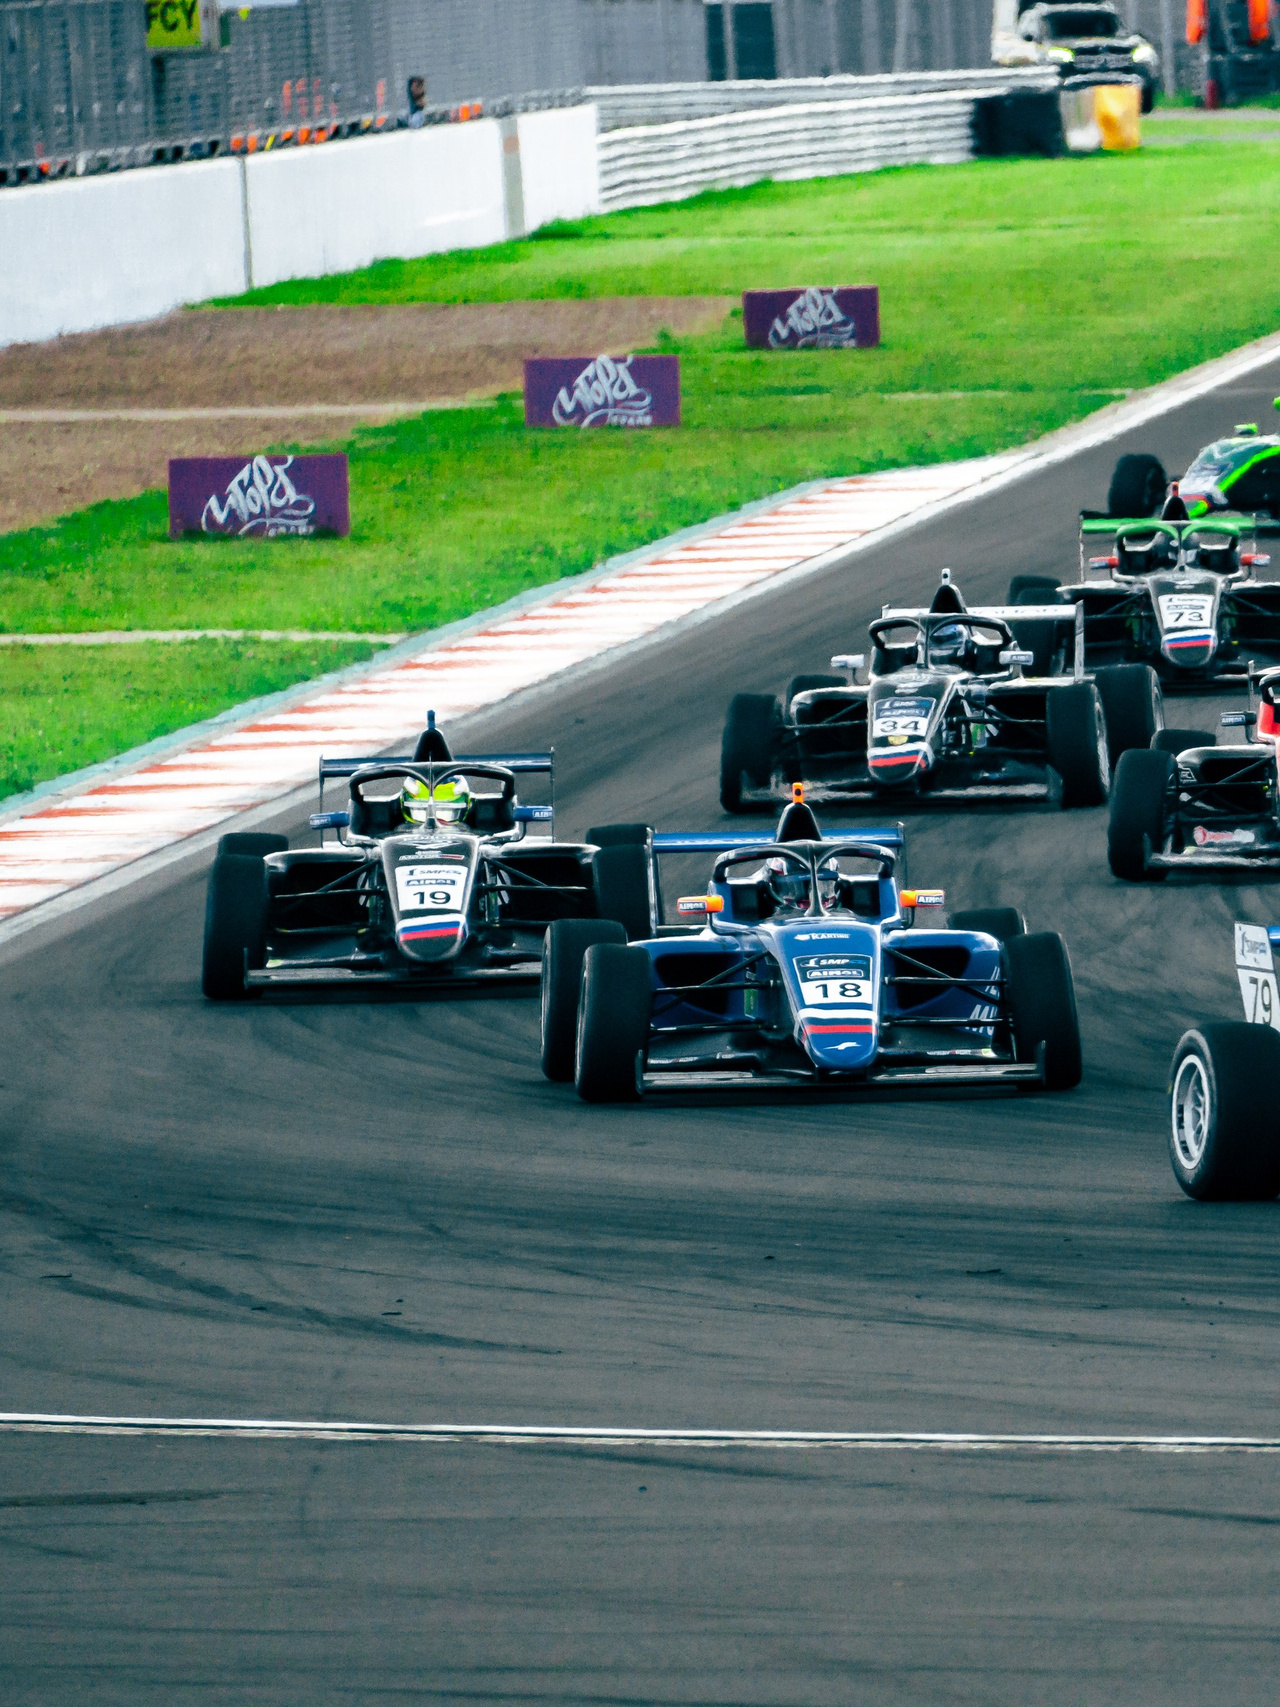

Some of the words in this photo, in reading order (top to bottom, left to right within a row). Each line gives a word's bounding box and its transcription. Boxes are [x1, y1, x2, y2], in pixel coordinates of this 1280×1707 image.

[146, 0, 198, 31] FCY
[1168, 611, 1204, 623] 73
[880, 720, 920, 733] 34
[412, 890, 452, 905] 19
[815, 983, 862, 998] 18
[1248, 976, 1272, 1026] 79
